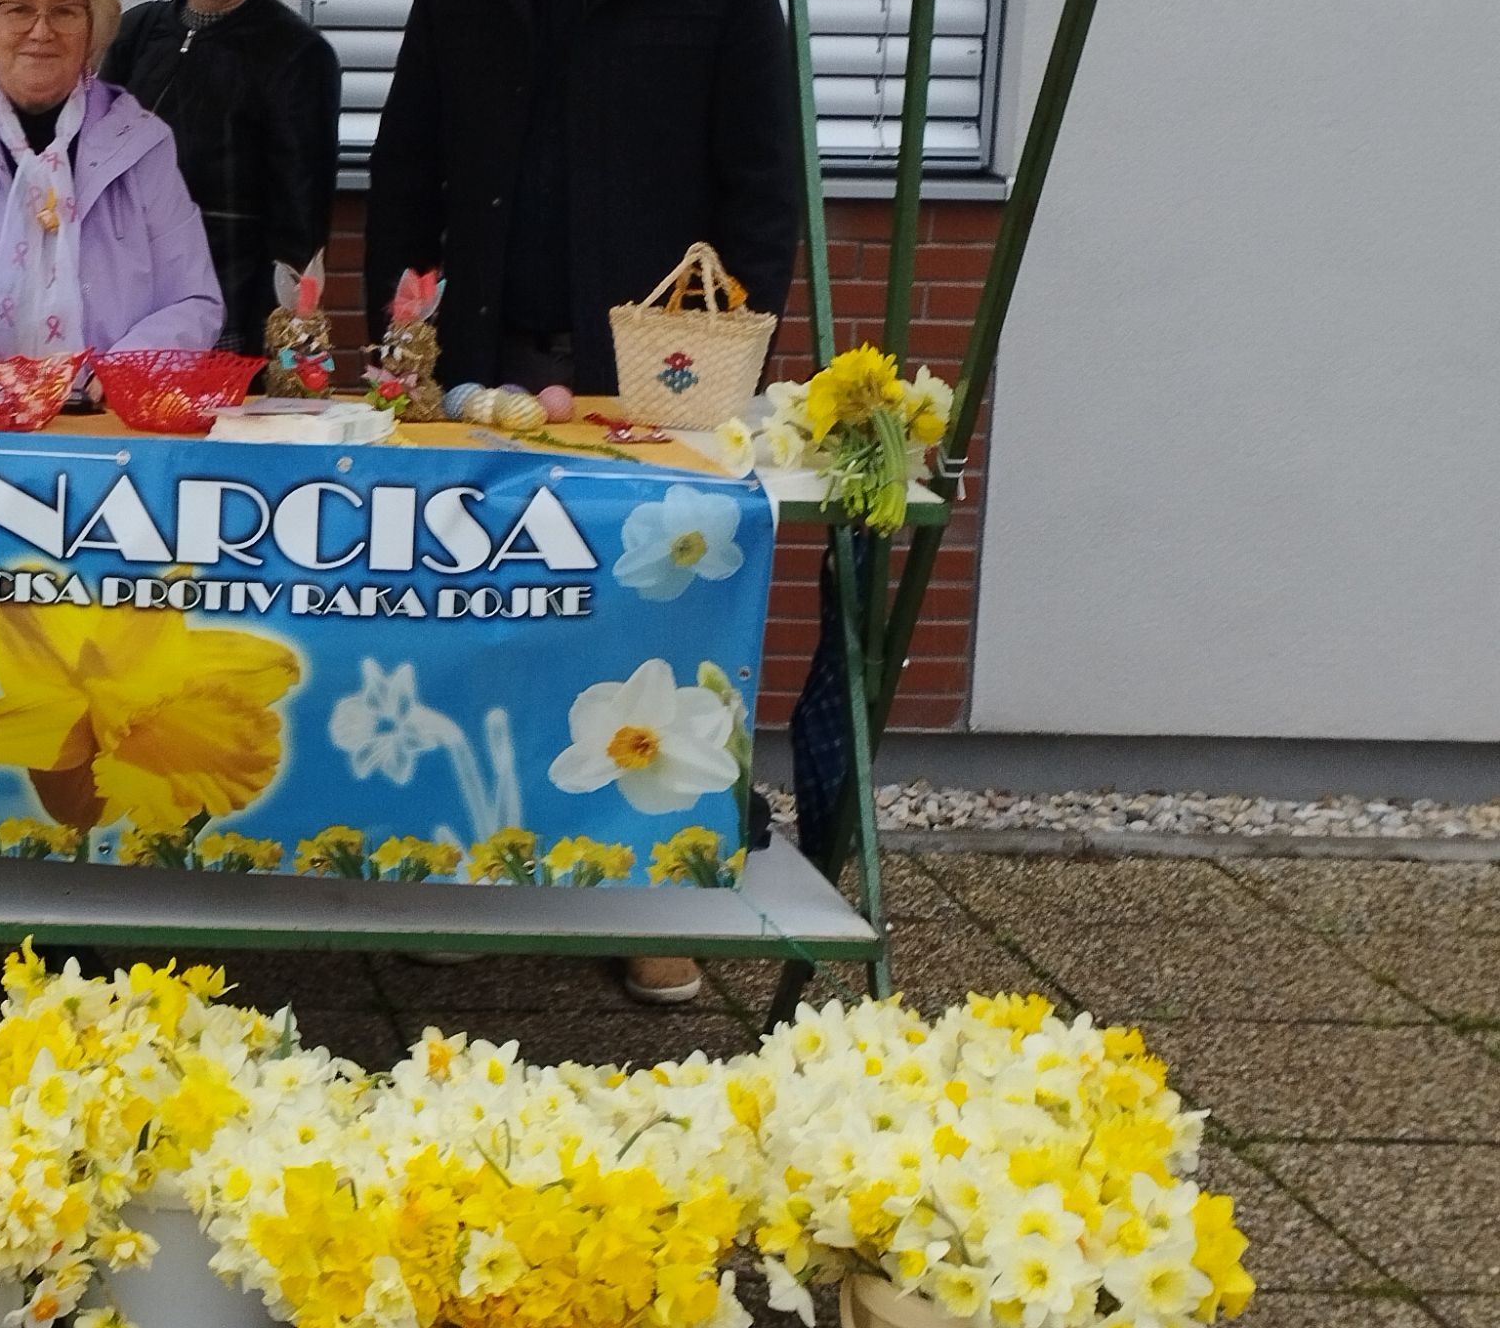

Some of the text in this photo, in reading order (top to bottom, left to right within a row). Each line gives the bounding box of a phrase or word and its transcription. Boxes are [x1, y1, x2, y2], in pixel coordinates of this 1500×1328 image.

[102, 576, 282, 613] PROTIV
[292, 585, 426, 618] RAKA
[437, 586, 592, 618] DOJKE
